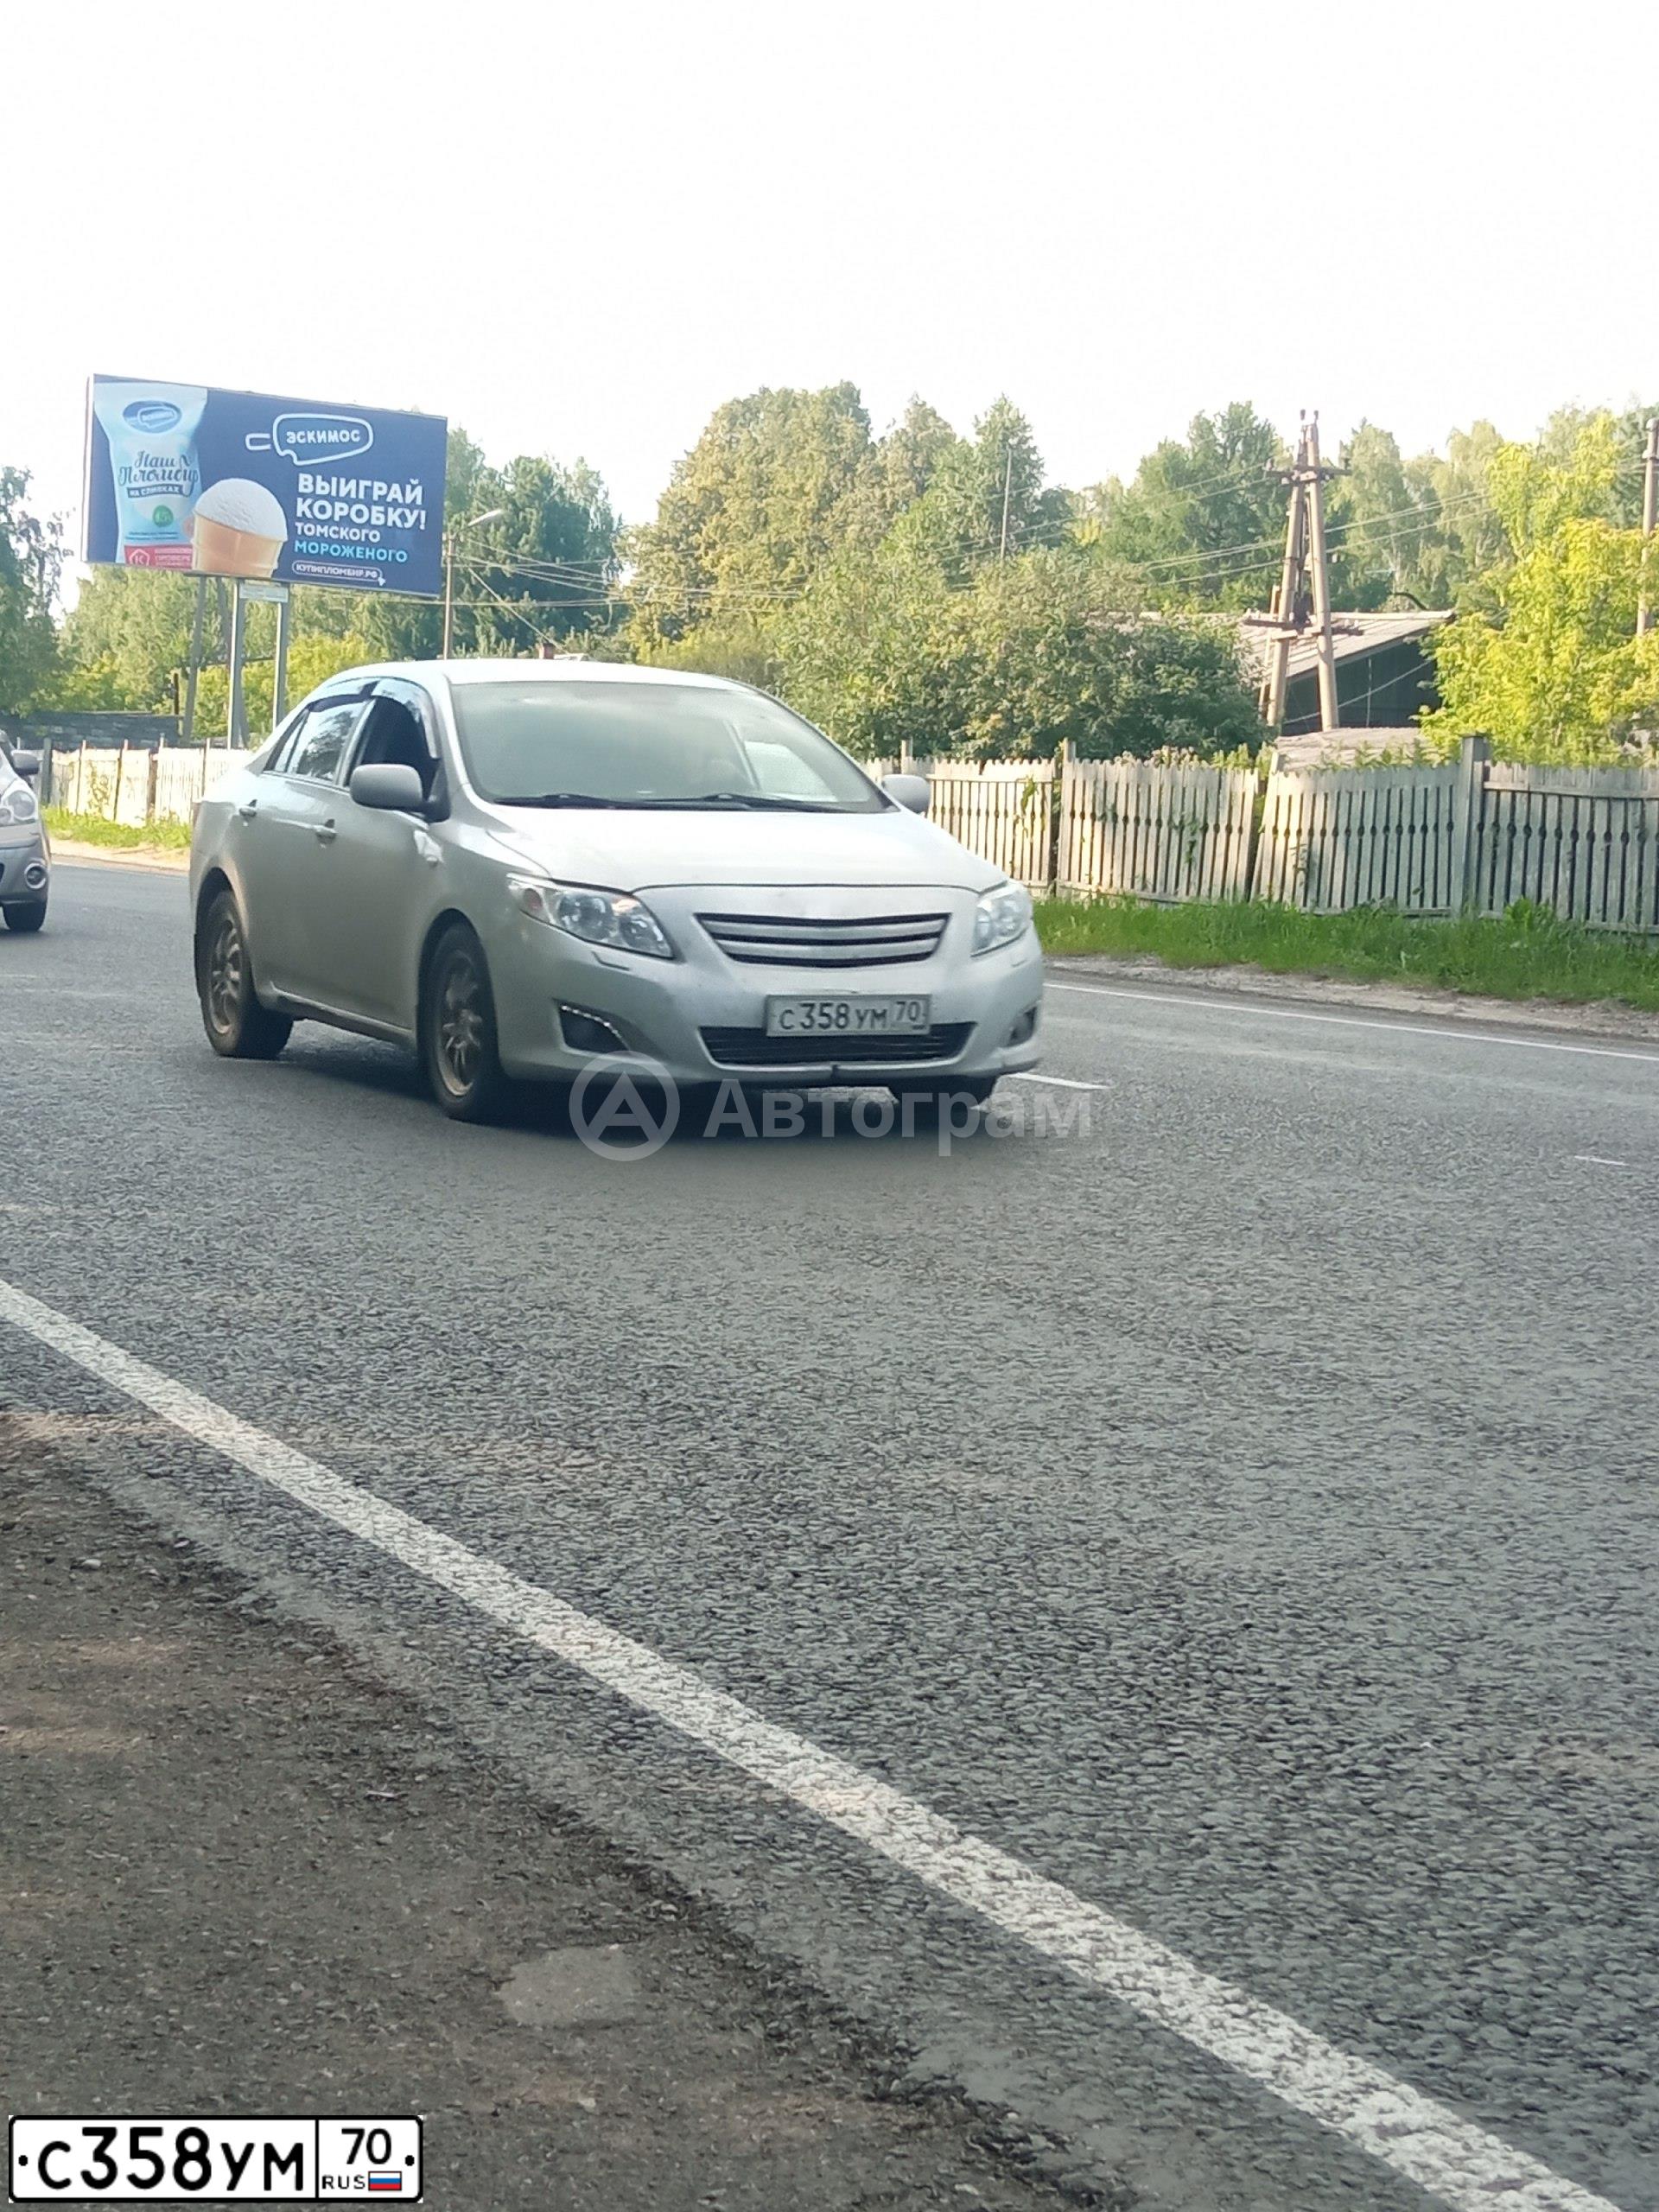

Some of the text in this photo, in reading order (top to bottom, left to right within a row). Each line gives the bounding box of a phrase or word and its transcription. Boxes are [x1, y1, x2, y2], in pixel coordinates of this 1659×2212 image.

[298, 473, 423, 505] ВЫИГРАЙ
[296, 497, 427, 531] КОРОБКУ!
[295, 522, 381, 543] ТОМСКОГО
[294, 539, 408, 563] МОРОЖЕНОГО
[779, 1001, 920, 1030] С358УМ 70
